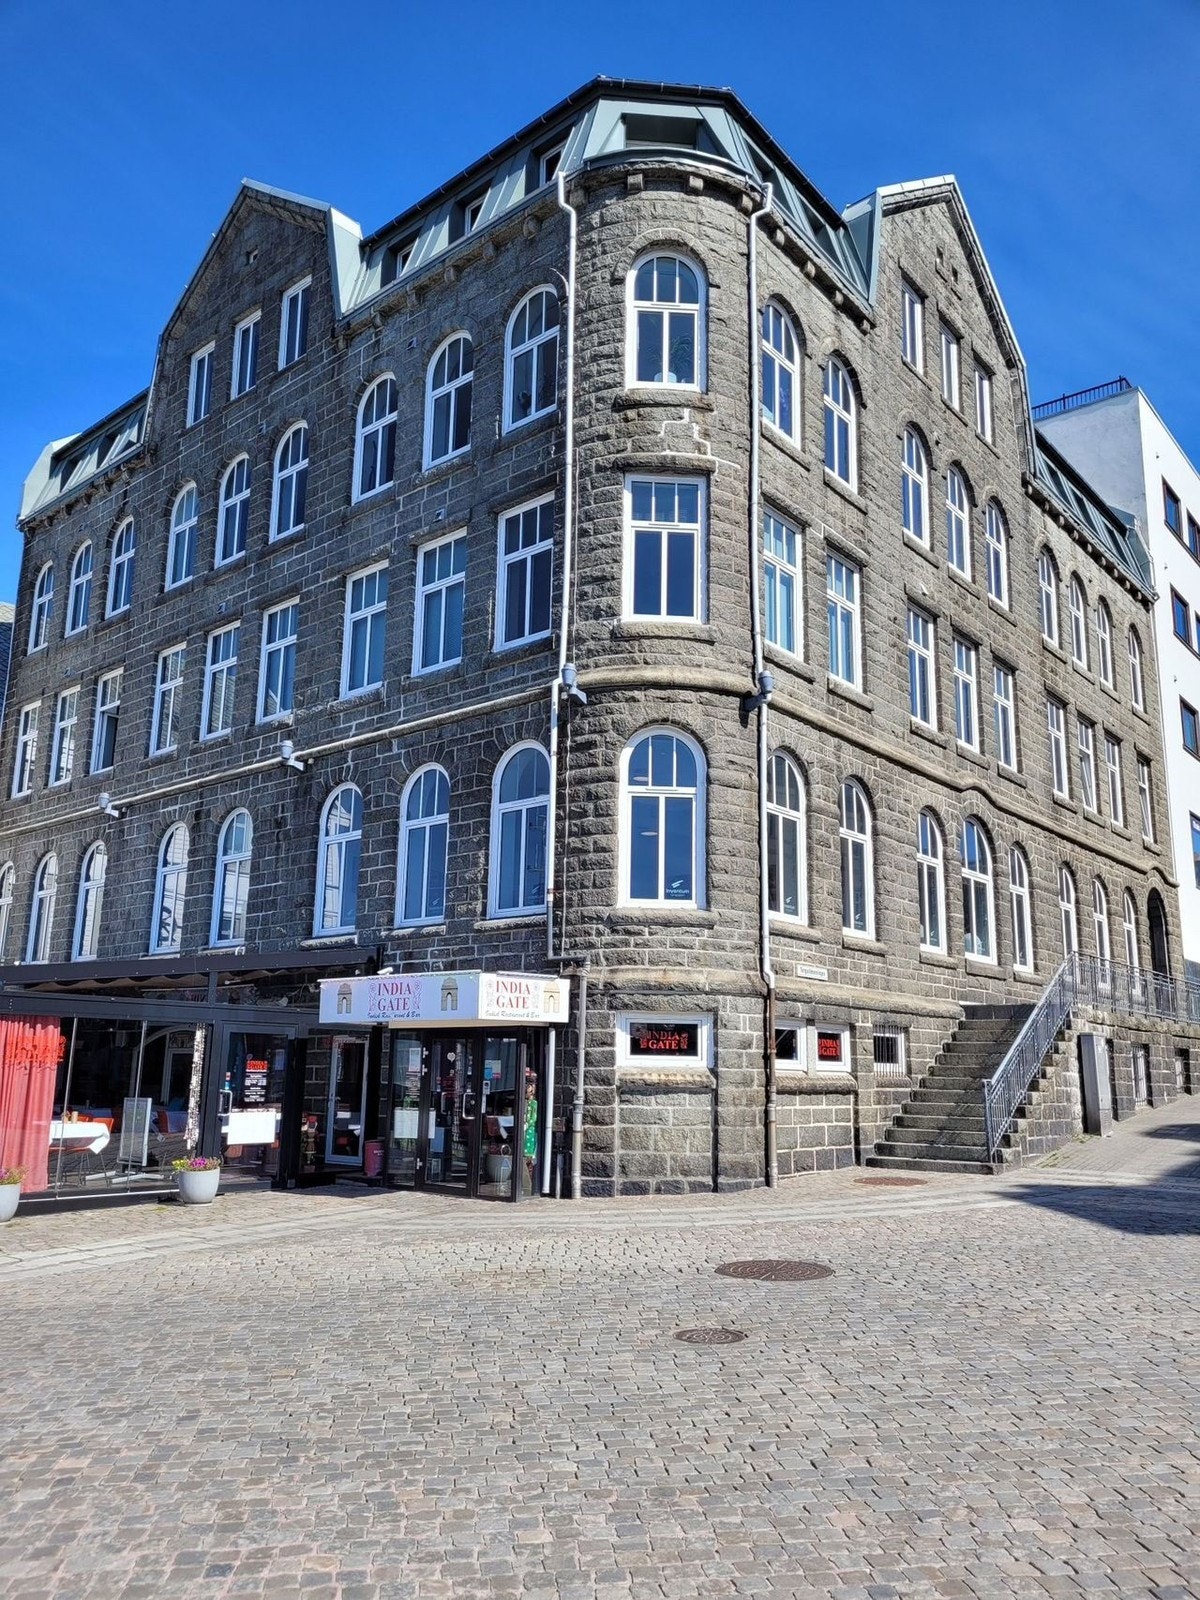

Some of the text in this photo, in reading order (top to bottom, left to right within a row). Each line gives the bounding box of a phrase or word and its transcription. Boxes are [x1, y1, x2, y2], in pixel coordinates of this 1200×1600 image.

[378, 982, 412, 996] INDIA
[496, 980, 531, 995] INDIA
[377, 997, 410, 1011] GATE
[496, 995, 529, 1009] GATE
[646, 1030, 680, 1040] INDIA
[648, 1039, 679, 1050] GATE
